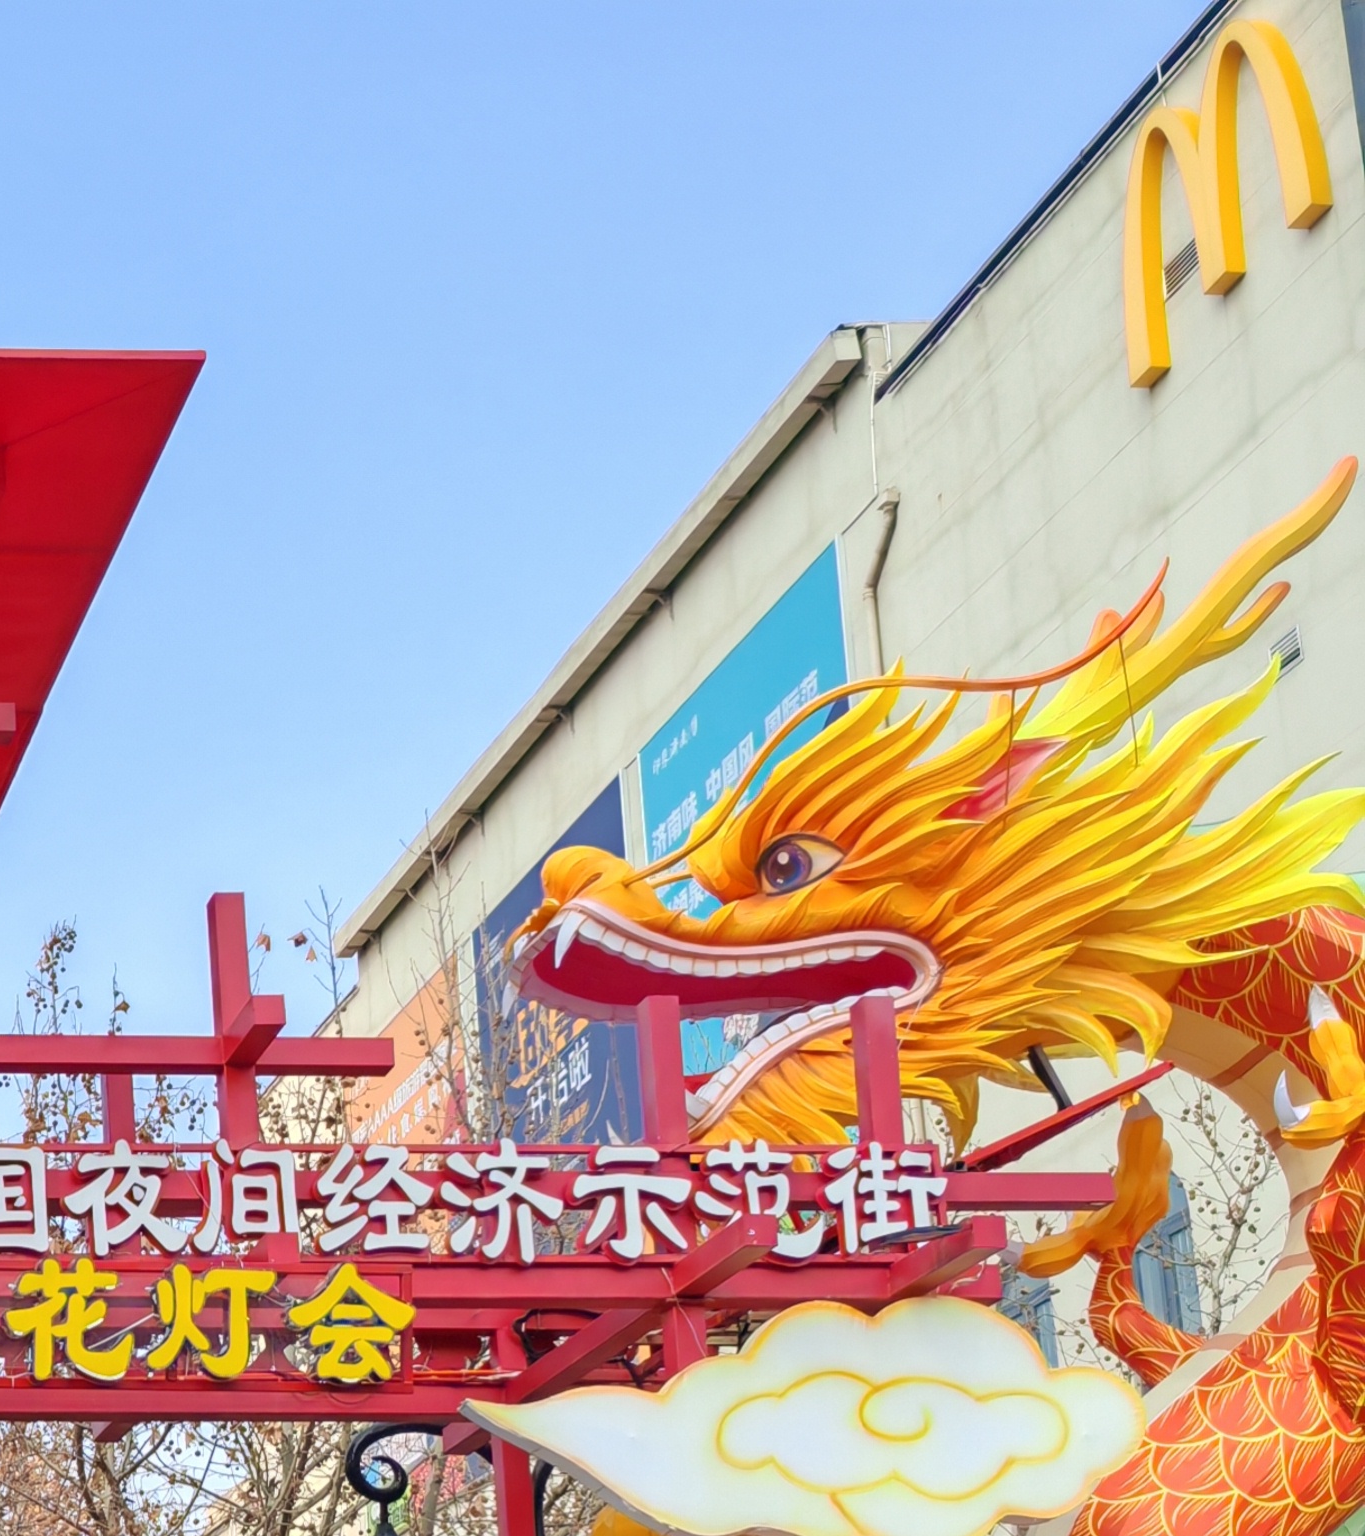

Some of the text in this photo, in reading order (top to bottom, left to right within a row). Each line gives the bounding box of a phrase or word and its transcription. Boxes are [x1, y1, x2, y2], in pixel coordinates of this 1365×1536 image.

[651, 790, 698, 862] 济南味
[704, 731, 755, 802] 中国风
